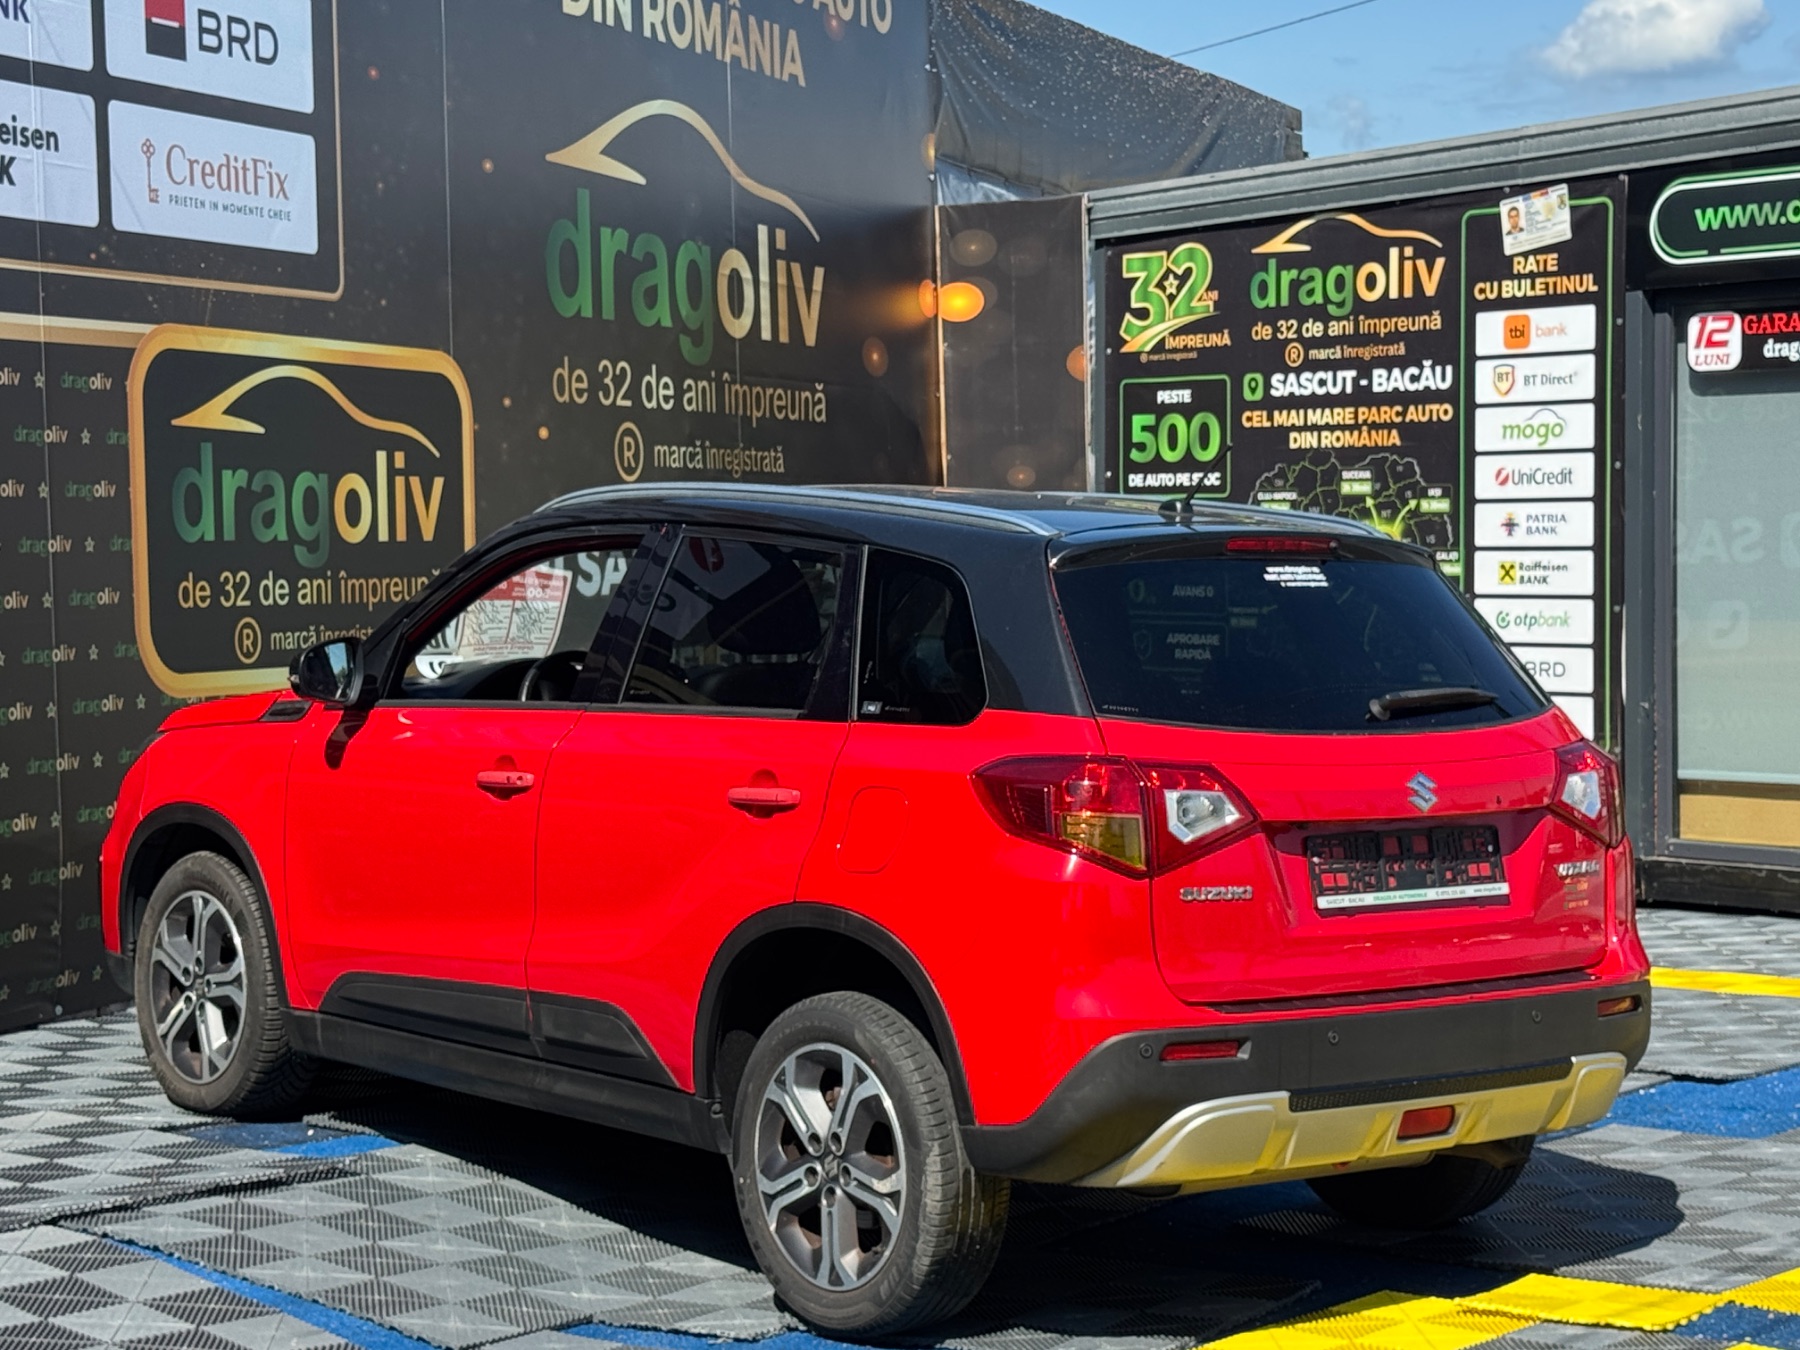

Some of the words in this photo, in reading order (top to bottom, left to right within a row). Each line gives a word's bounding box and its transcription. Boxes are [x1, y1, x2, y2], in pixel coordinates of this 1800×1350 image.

[198, 9, 279, 65] BRD
[643, 0, 806, 87] ROMÂNIA
[166, 144, 290, 201] CreditFix
[169, 194, 206, 209] PRIETEN
[209, 201, 219, 211] IN
[222, 203, 264, 218] MOMENTE
[267, 209, 291, 222] CHEIE
[1512, 253, 1559, 275] RATE
[545, 188, 825, 366] dragoliv
[1250, 246, 1446, 317] dragoliv
[1473, 281, 1499, 300] CU
[1501, 273, 1598, 299] BULETINUL
[1119, 242, 1213, 342] 32
[1200, 290, 1219, 301] ANI
[1251, 321, 1273, 341] de
[1276, 319, 1298, 340] 32
[1302, 317, 1324, 338] de
[1328, 315, 1354, 337] ani
[1358, 310, 1442, 338] împreună
[1509, 324, 1525, 339] tbi
[1535, 323, 1568, 338] bank
[1694, 314, 1734, 349] 12
[1165, 329, 1231, 350] ÎMPREUNĂ
[1308, 346, 1342, 361] marcă
[1343, 341, 1406, 361] înregistrată
[1695, 354, 1731, 367] LUNI
[60, 371, 112, 393] dragoliv
[1269, 370, 1357, 397] SASCUT
[1372, 359, 1453, 392] BACĂU
[1497, 371, 1510, 383] BT
[1523, 374, 1537, 386] BT
[553, 356, 588, 404] de
[599, 359, 632, 407] 32
[641, 364, 675, 411] de
[683, 370, 716, 414] ani
[722, 371, 827, 427] împreună
[1157, 389, 1192, 404] PESTE
[1241, 410, 1271, 428] CEL
[1273, 408, 1304, 427] MAI
[1307, 406, 1355, 426] MARE
[1358, 405, 1403, 424] PARC
[1405, 403, 1454, 423] AUTO
[14, 424, 68, 446] dragoliv
[1129, 411, 1221, 464] 500
[1289, 431, 1318, 449] DIN
[1320, 426, 1401, 447] ROMÂNIA
[1502, 422, 1564, 447] mogo
[654, 440, 703, 469] marcă
[705, 440, 785, 479] înregistrată
[1128, 473, 1144, 487] DE
[1145, 473, 1175, 487] AUTO
[1176, 473, 1191, 487] PE
[1511, 467, 1573, 486] UniCredit
[64, 480, 116, 501] dragoliv
[172, 442, 445, 568] dragoliv
[1526, 514, 1567, 524] PATRIA
[1526, 526, 1557, 536] BANK
[18, 534, 72, 557] dragoliv
[1518, 561, 1568, 572] Raiffeisen
[178, 571, 211, 609] de
[219, 570, 251, 607] 32
[259, 569, 290, 606] de
[297, 569, 332, 605] ani
[1519, 575, 1549, 585] BANK
[69, 587, 120, 609] dragoliv
[270, 624, 317, 650] marcă
[22, 644, 76, 667] dragoliv
[72, 694, 124, 716] dragoliv
[26, 752, 80, 776] dragoliv
[28, 861, 84, 886] dragoliv
[1179, 885, 1253, 901] SUZUKI
